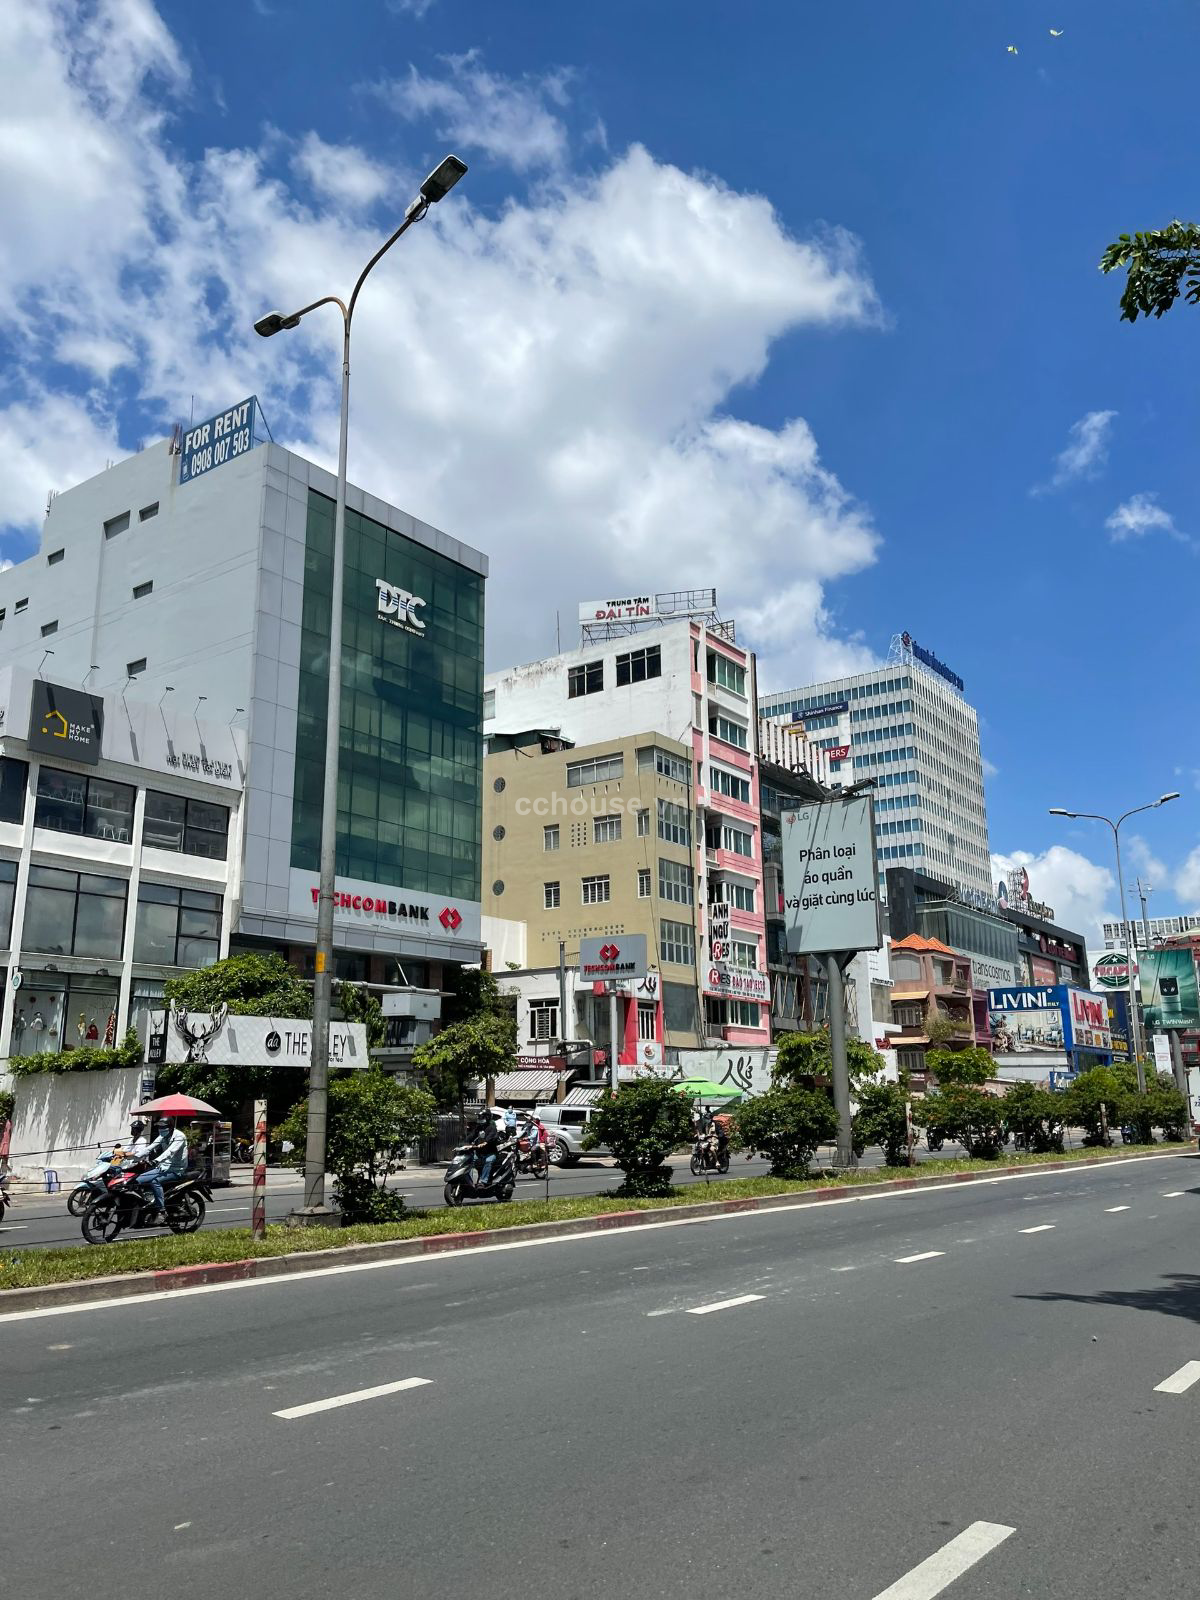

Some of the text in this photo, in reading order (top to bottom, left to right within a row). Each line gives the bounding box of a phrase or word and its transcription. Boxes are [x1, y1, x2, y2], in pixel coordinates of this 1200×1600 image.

[185, 402, 250, 454] FOR RENT
[191, 428, 249, 476] 0908 007 503
[376, 579, 427, 628] DTC
[595, 604, 650, 620] ĐẠI TÍN
[69, 723, 91, 733] MAKE
[68, 734, 90, 744] HOME
[797, 812, 809, 821] LG
[799, 843, 856, 862] Phân loại
[804, 865, 853, 885] áo quần
[311, 888, 430, 921] TCHCOMBANK
[785, 888, 875, 910] và giặt cùng lúc
[713, 904, 729, 919] ANH
[713, 941, 730, 960] RES
[709, 968, 731, 986] RES
[989, 991, 1048, 1009] LIVINI
[152, 1037, 161, 1047] THE
[284, 1031, 308, 1056] THE
